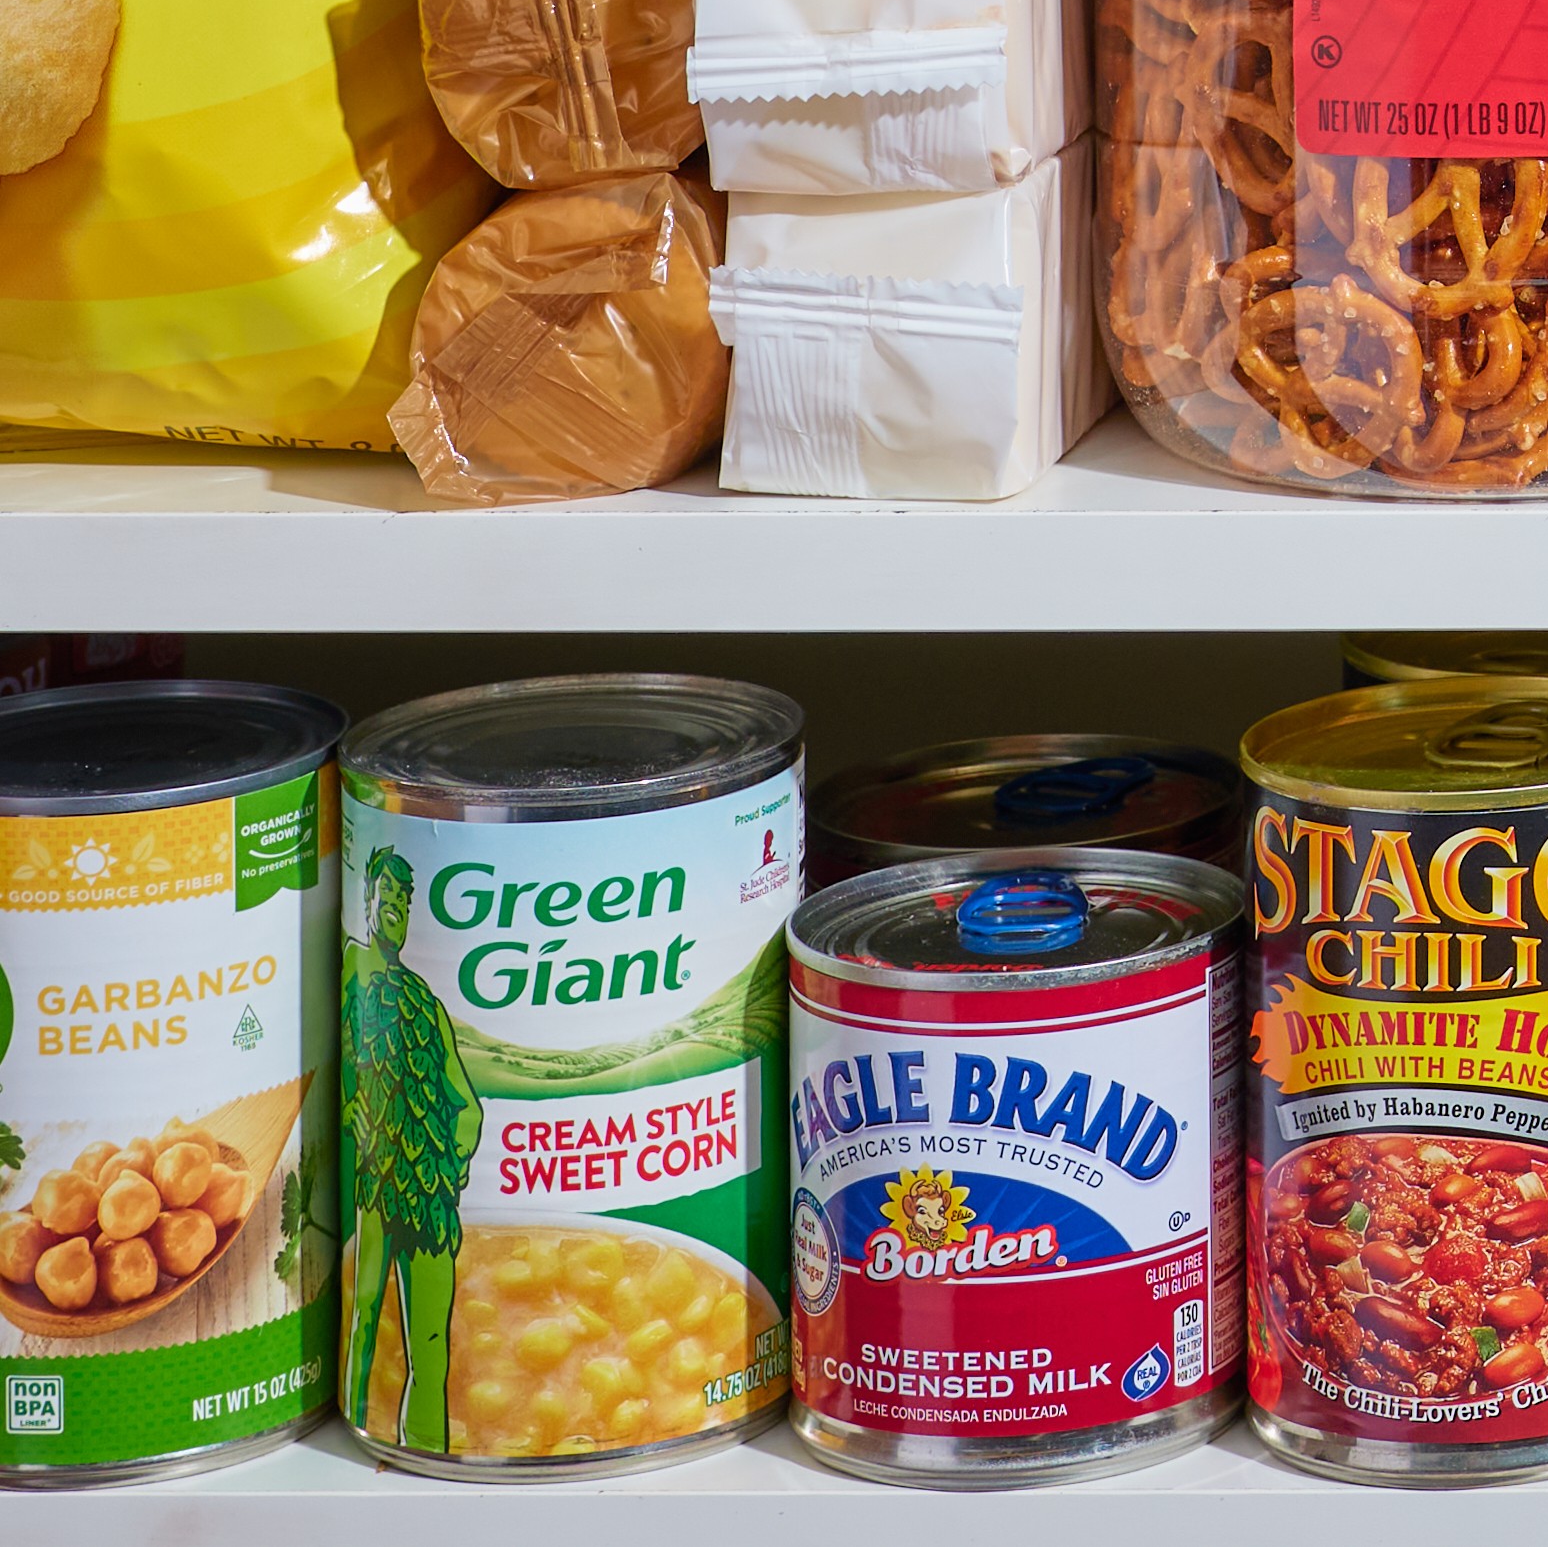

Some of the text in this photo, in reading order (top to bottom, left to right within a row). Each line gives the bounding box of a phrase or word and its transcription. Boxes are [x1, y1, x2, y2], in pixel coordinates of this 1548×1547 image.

[428, 865, 687, 930] Green
[38, 955, 277, 1017] GARBANZO
[458, 934, 697, 1010] Giant
[1306, 929, 1543, 992] CHILI
[38, 1017, 188, 1056] BEANS
[1285, 1009, 1480, 1054] DYNAMITE
[792, 1051, 1178, 1182] EAGLE BRAND
[1293, 1099, 1347, 1132] Ignited
[1351, 1098, 1377, 1123] by
[1383, 1097, 1485, 1120] Habanero
[499, 1126, 738, 1195] SWEET CORN
[866, 1226, 1055, 1280] Borden
[824, 1359, 1112, 1399] CONDENSED MILK
[861, 1343, 1053, 1371] SWEETENED
